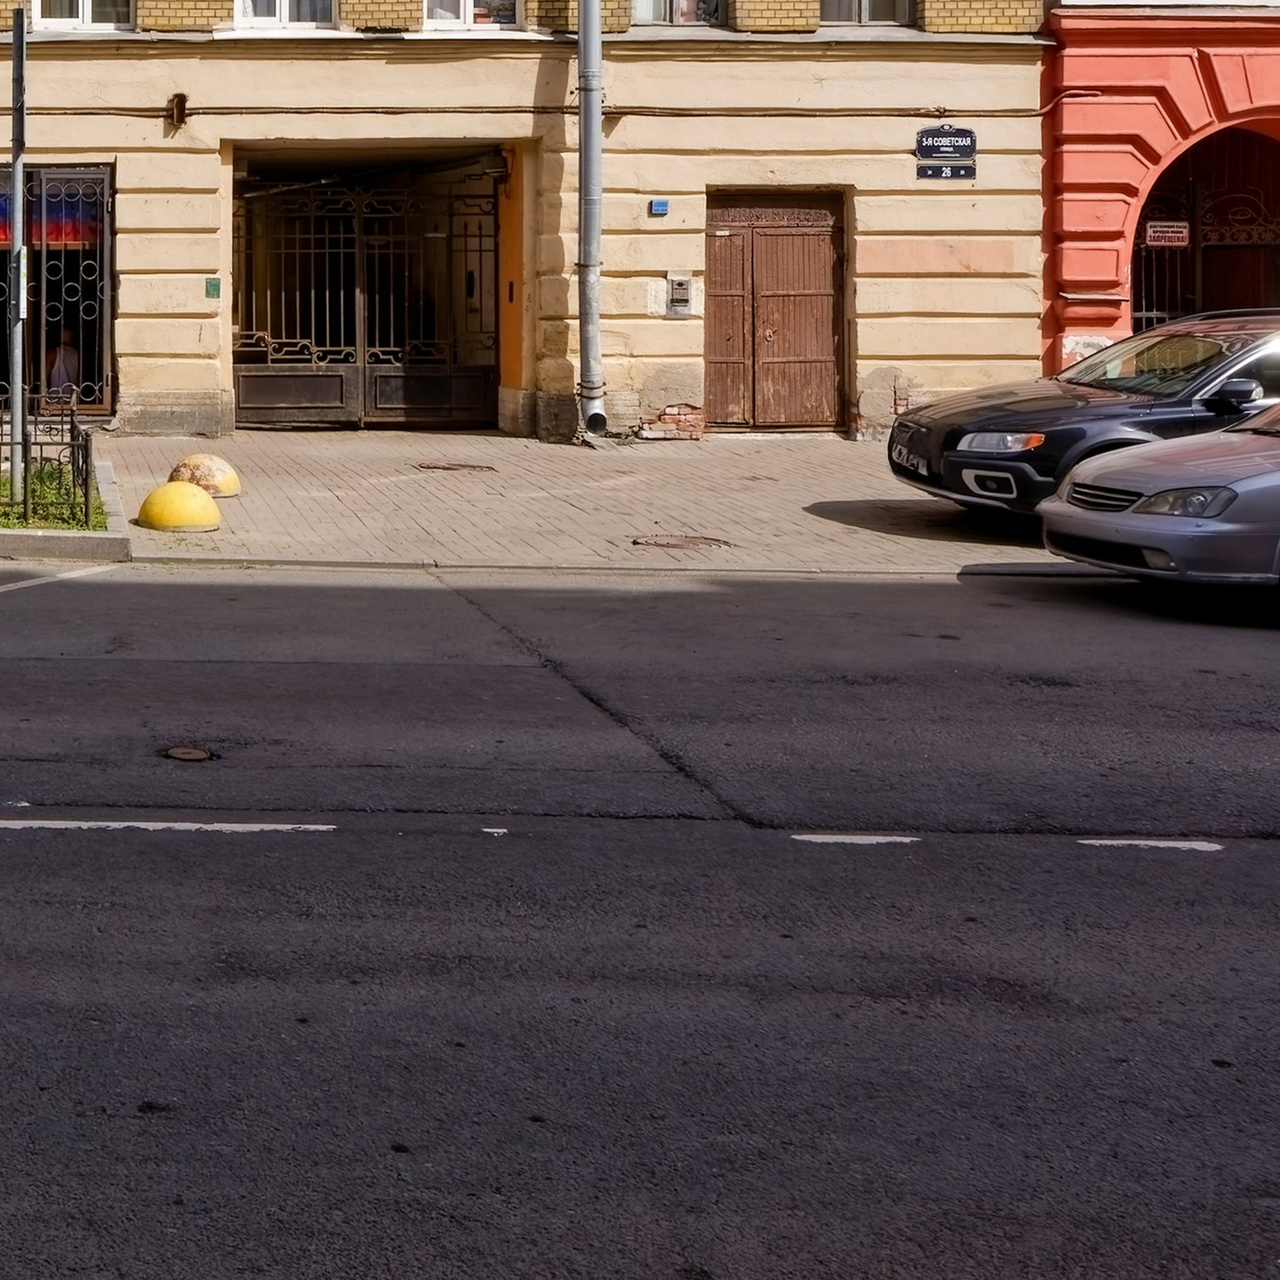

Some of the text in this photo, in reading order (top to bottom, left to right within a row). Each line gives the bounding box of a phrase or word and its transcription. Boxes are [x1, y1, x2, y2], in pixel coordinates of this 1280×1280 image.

[922, 137, 971, 146] 3-Я СОВЕТСКАЯ
[941, 167, 952, 177] 26
